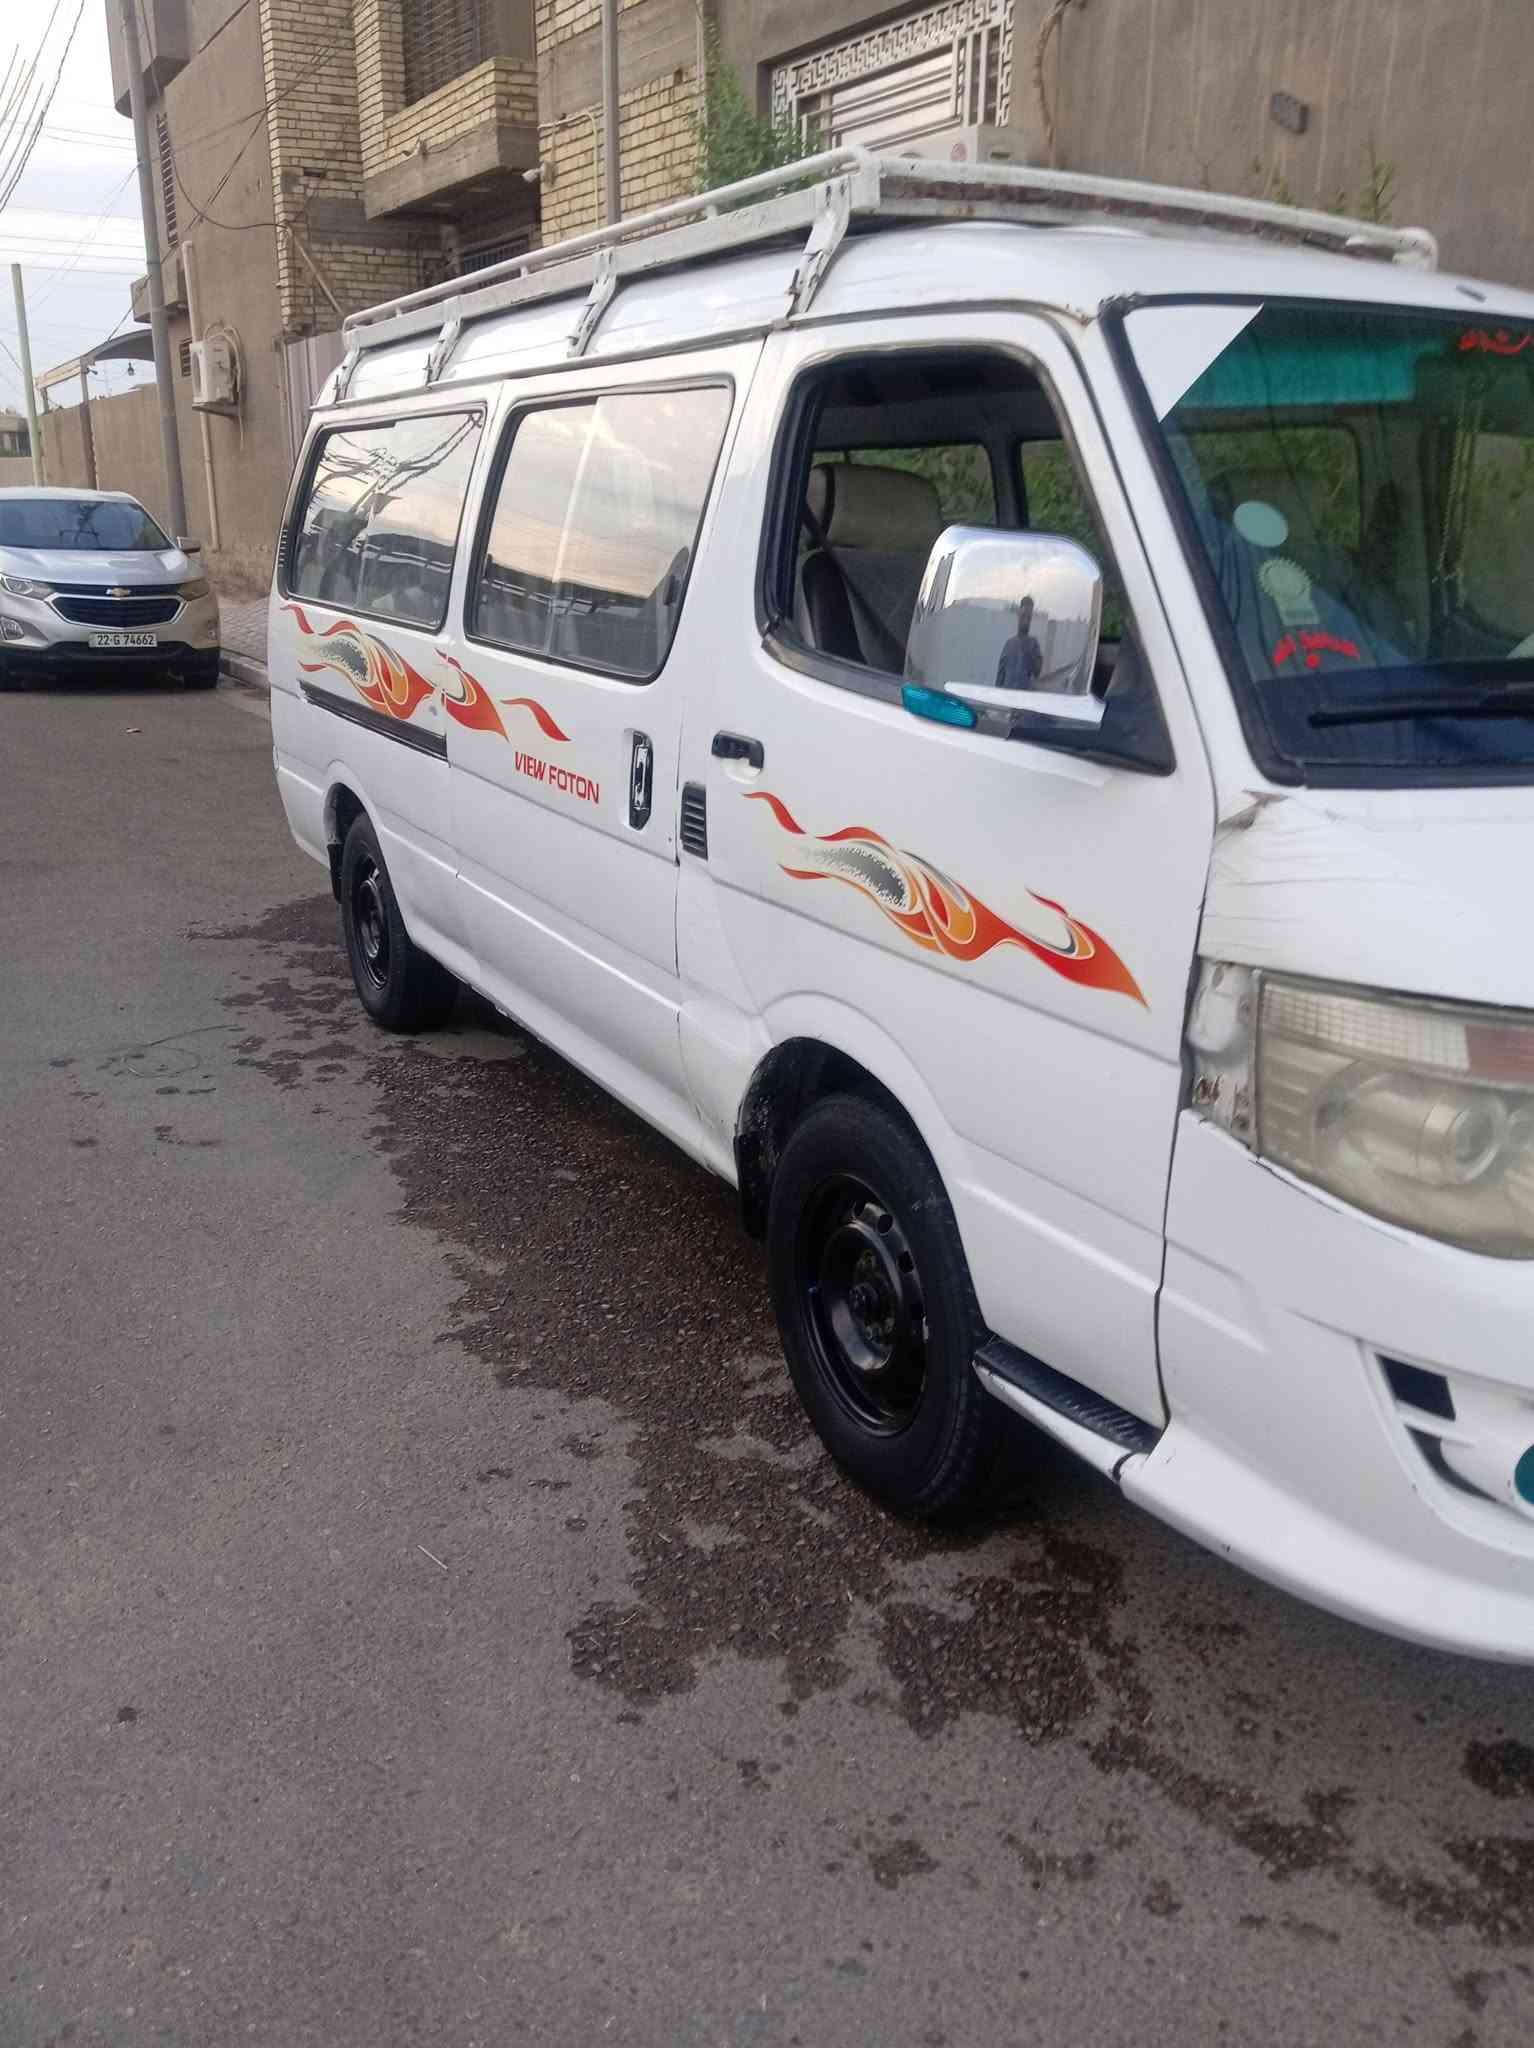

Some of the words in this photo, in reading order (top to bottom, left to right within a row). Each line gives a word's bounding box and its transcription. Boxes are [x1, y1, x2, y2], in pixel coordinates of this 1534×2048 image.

[97, 634, 110, 646] 22
[113, 634, 121, 646] G
[124, 634, 154, 646] 74662
[514, 751, 546, 781] VIEW
[548, 765, 599, 804] FOTON
